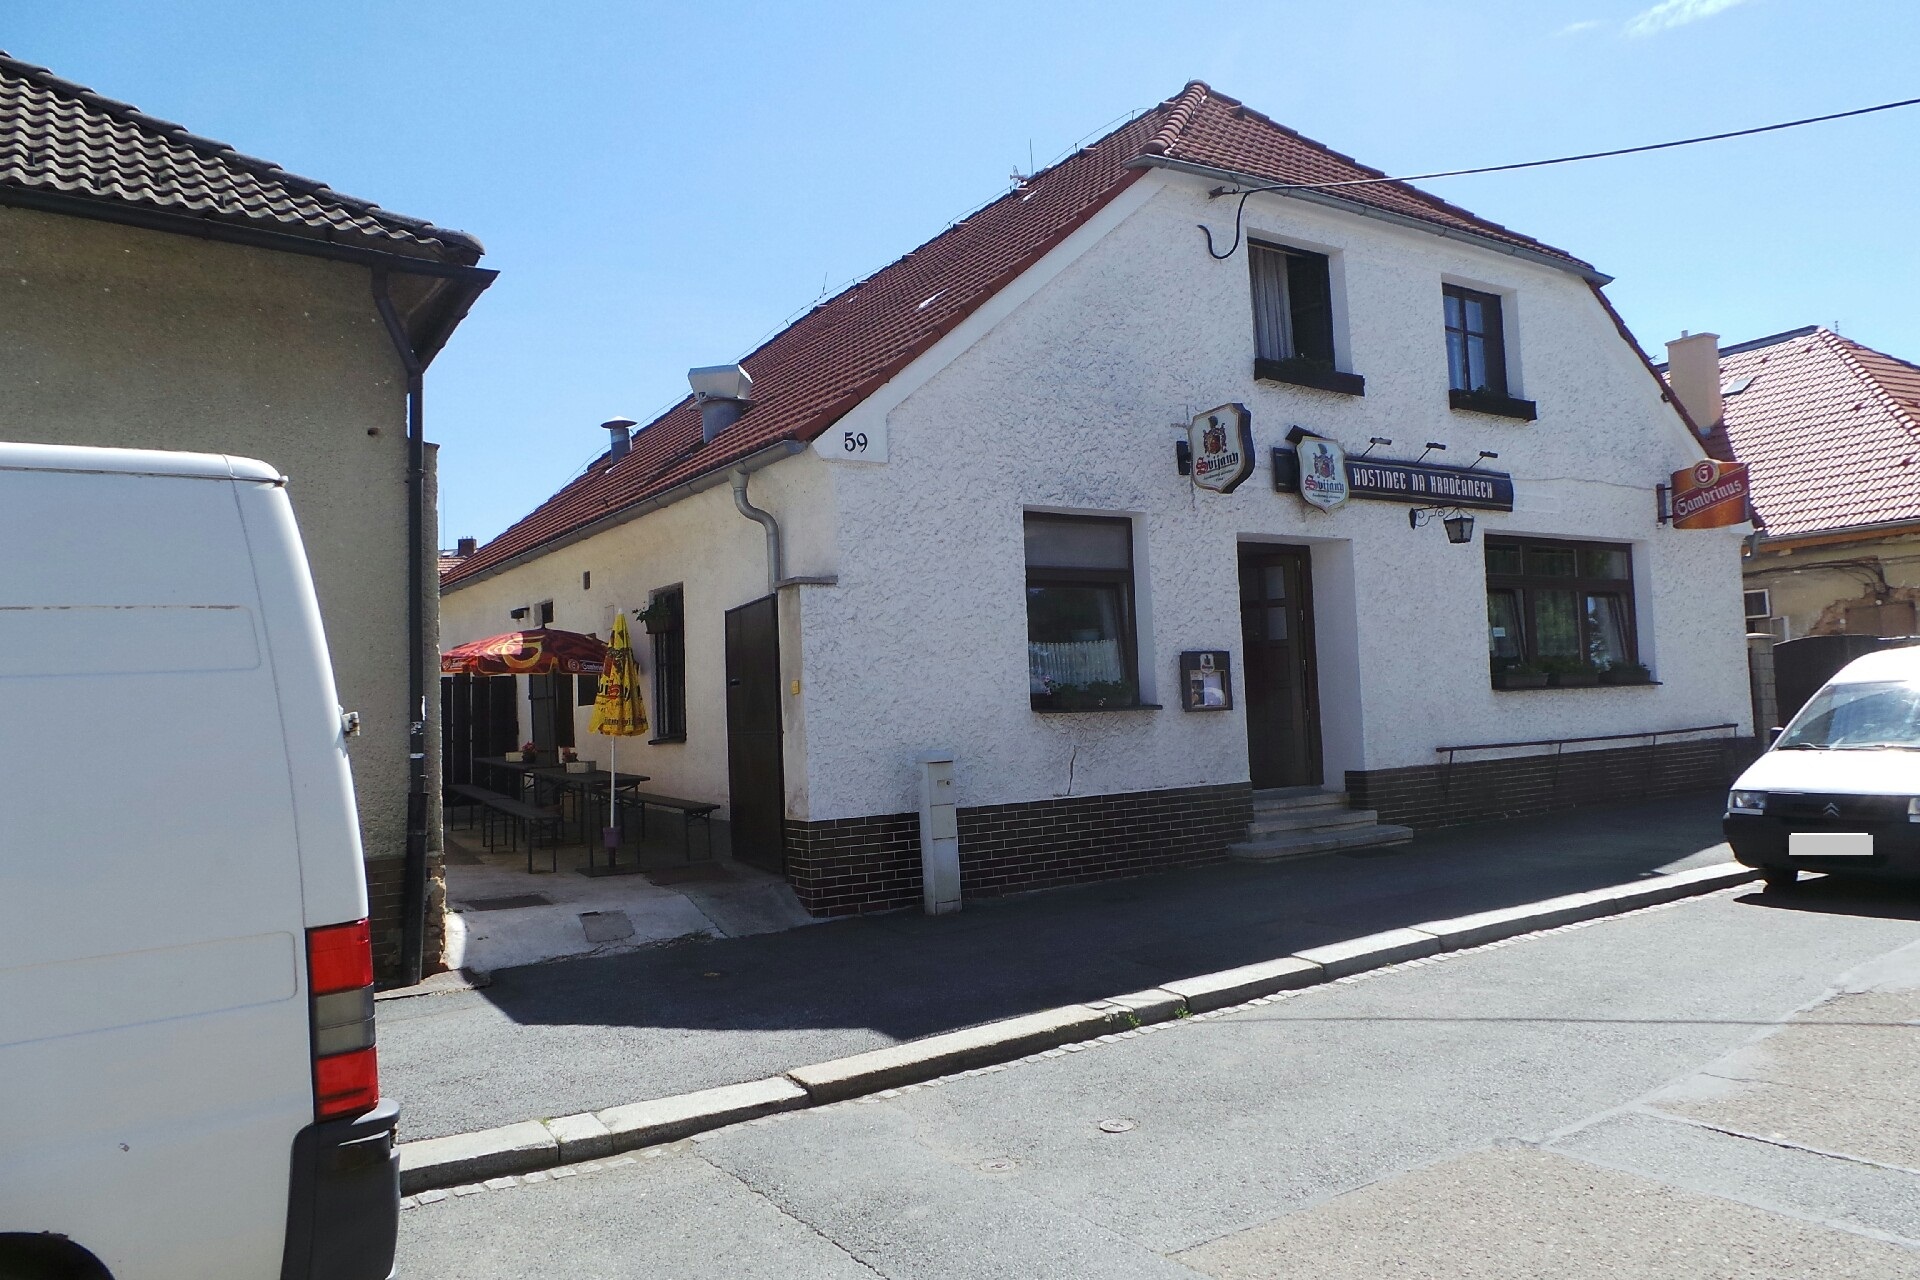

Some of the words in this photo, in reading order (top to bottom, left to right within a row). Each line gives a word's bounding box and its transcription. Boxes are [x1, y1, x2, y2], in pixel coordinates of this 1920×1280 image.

[844, 432, 868, 453] 59
[1196, 452, 1239, 475] Svijany
[1305, 474, 1344, 494] Svijany
[1353, 468, 1406, 490] HOSTINEC
[1412, 473, 1426, 492] NA
[1430, 475, 1493, 499] HRADČANECH
[1676, 480, 1743, 515] Gambrinus
